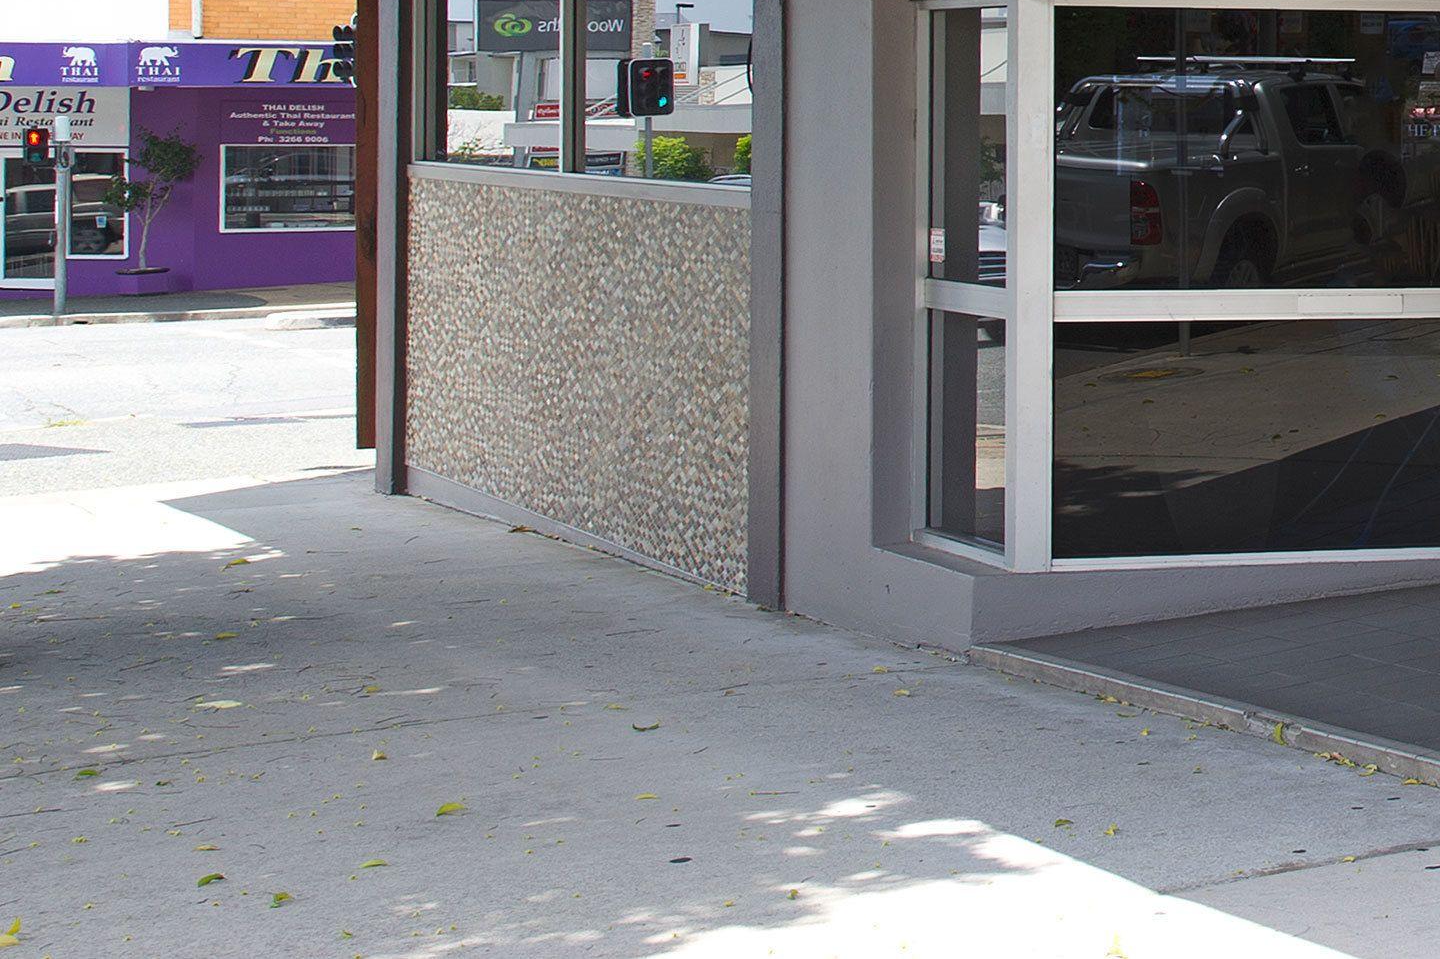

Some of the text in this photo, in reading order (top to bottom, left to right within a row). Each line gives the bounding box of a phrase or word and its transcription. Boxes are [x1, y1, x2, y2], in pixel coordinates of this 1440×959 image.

[60, 66, 99, 76] THAI
[135, 66, 180, 76] THAI
[303, 112, 356, 120] Restaurant
[15, 116, 95, 127] Restaant
[298, 120, 325, 129] Away
